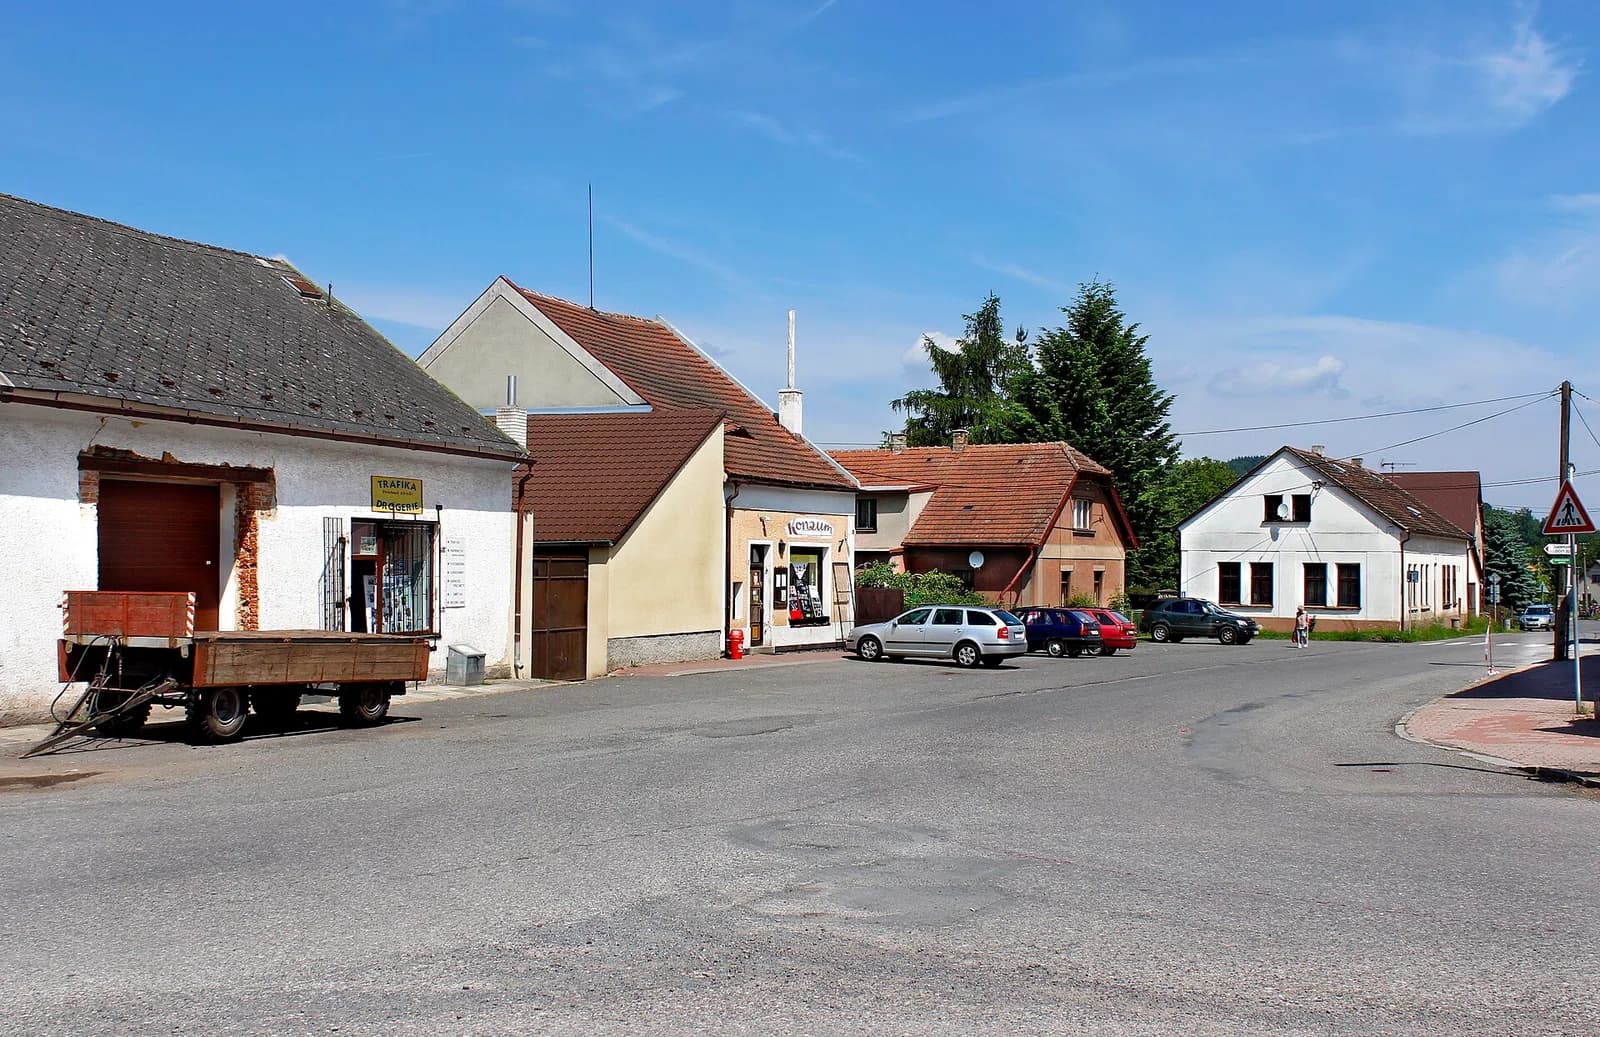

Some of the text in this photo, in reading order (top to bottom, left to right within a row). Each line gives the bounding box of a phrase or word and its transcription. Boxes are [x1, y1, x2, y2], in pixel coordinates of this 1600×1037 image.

[377, 480, 417, 491] TRAFIKA
[376, 500, 419, 512] DROGERIE
[787, 519, 832, 535] Konzum
